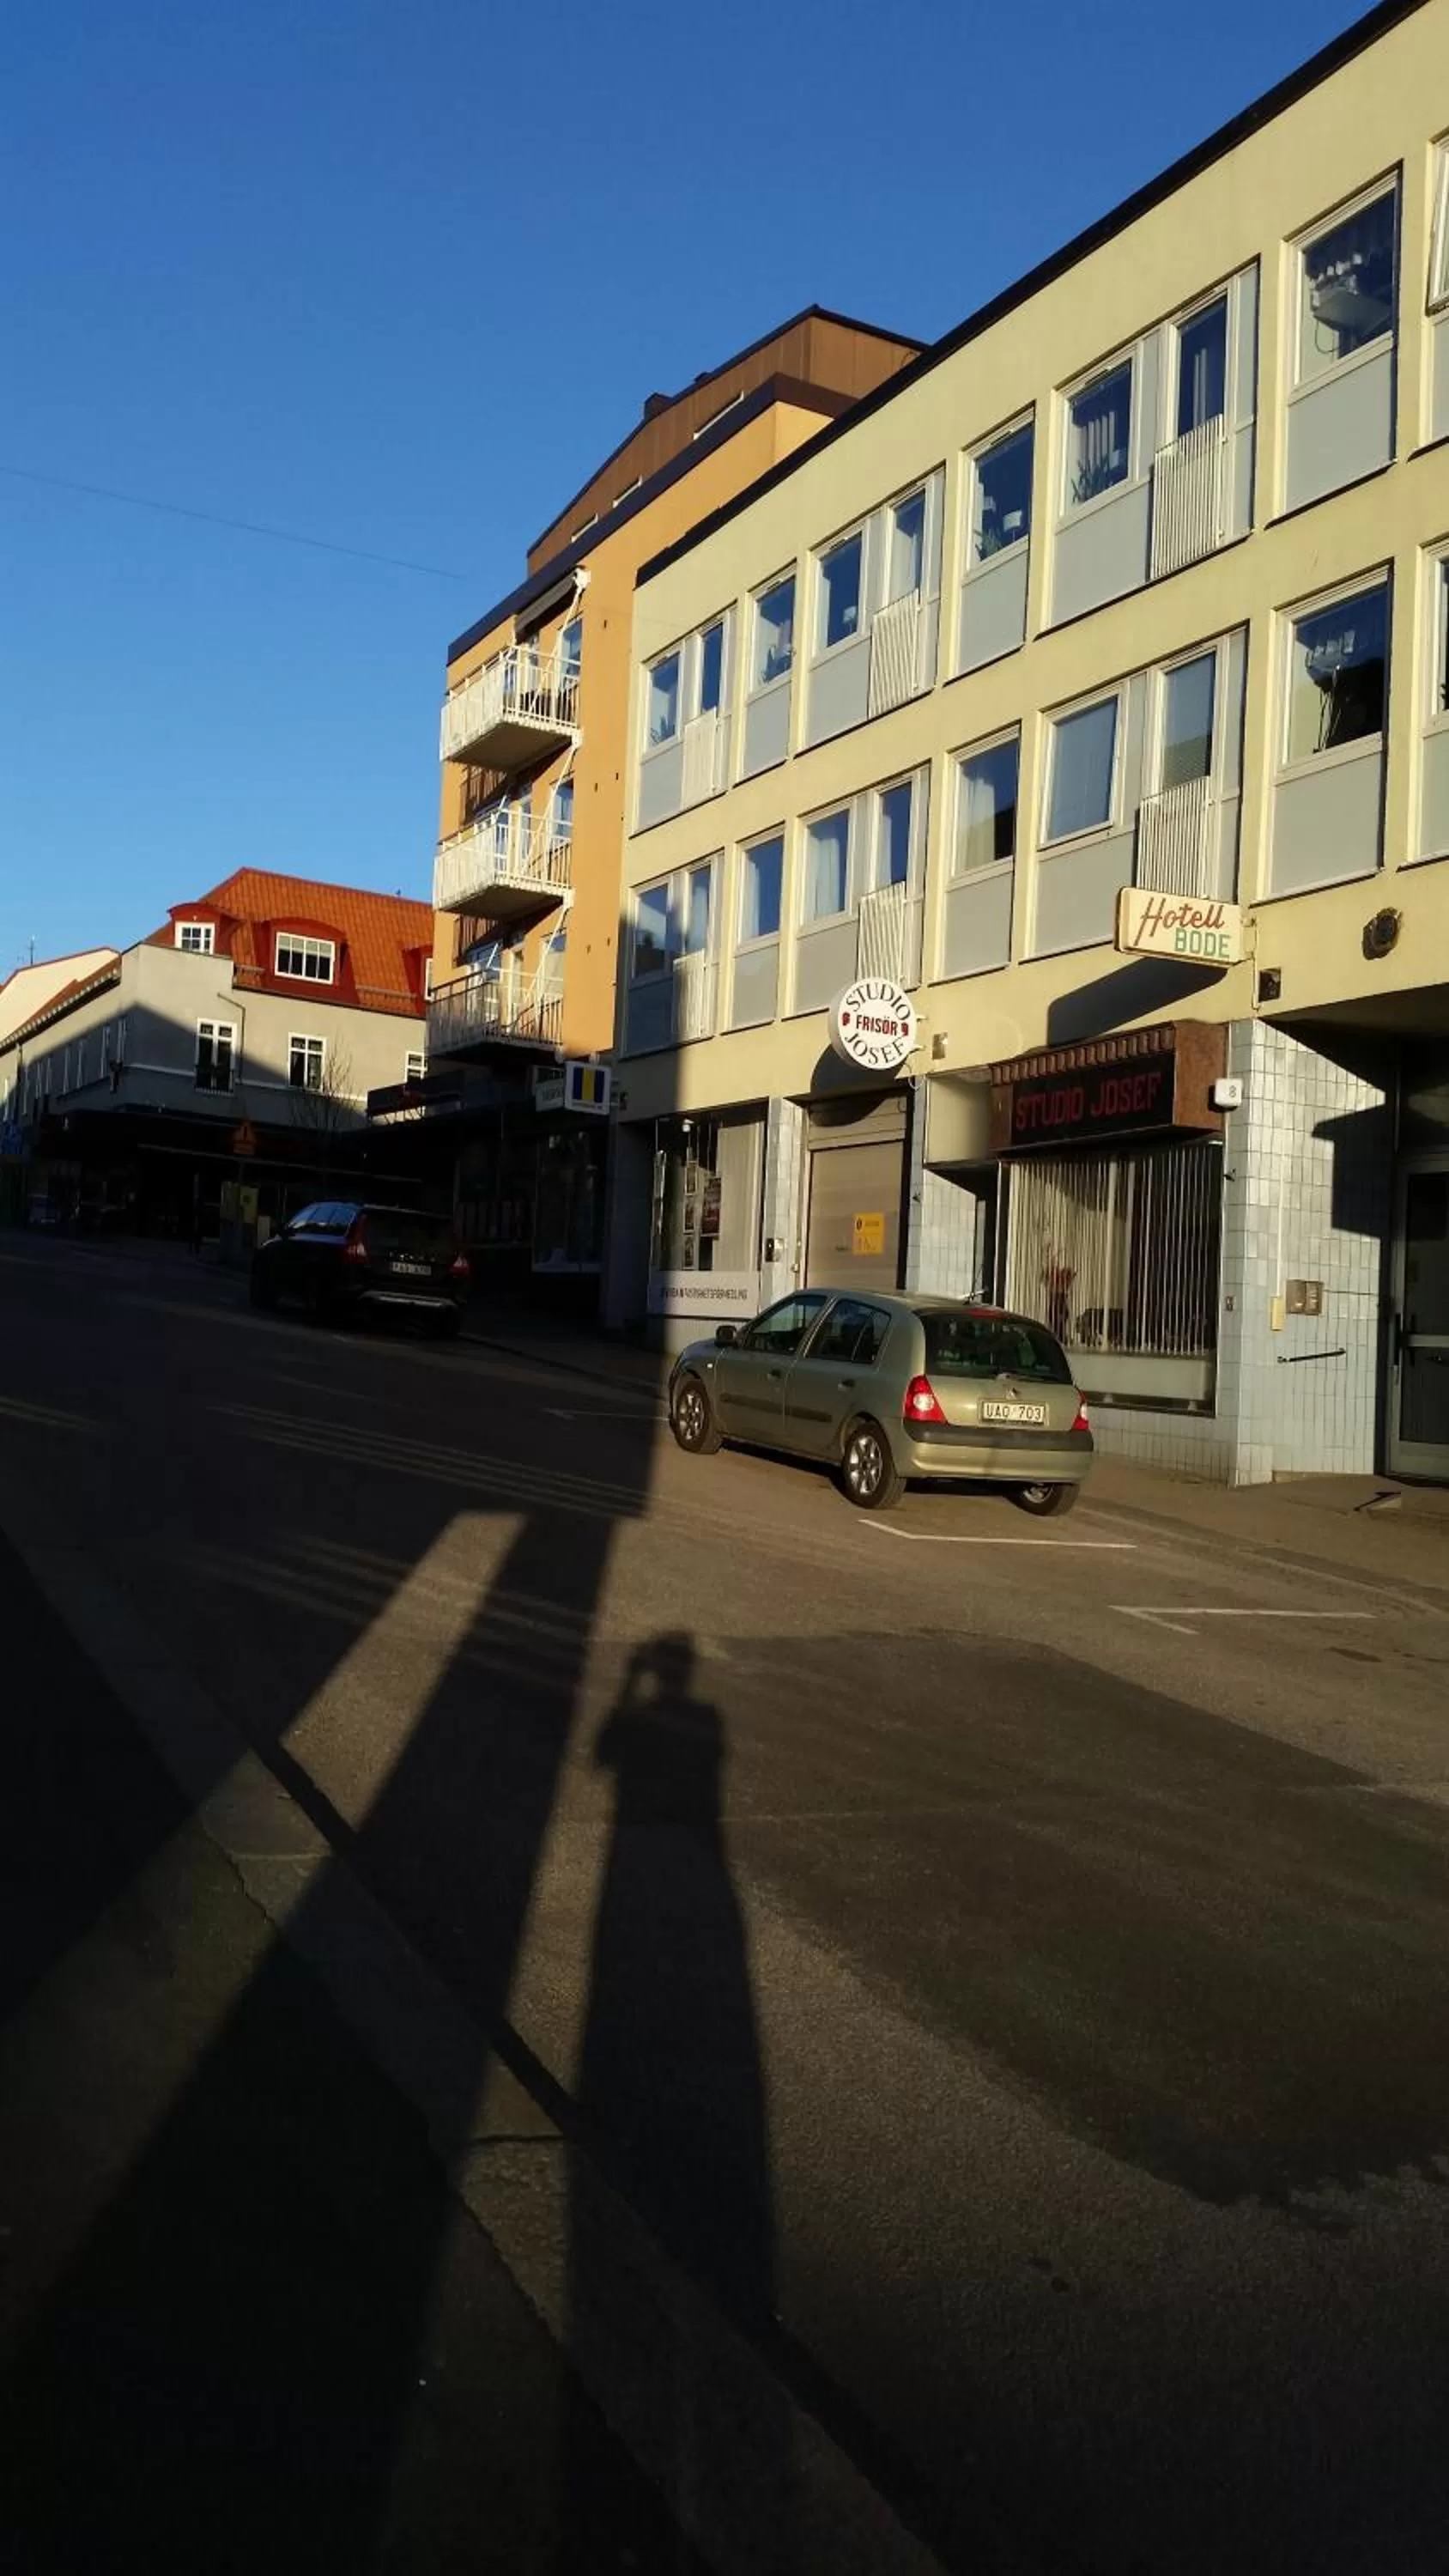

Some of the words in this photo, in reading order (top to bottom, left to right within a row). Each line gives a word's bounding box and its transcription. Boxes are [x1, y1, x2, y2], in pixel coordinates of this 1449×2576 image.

[1133, 896, 1225, 946] Hotell
[1174, 927, 1231, 958] BODE
[846, 982, 911, 1021] STUDIO
[856, 1014, 898, 1036] FRISÖR
[844, 1033, 905, 1065] JOSEF
[1016, 1085, 1084, 1131] STUDIO
[1090, 1072, 1162, 1117] JOSEF
[1018, 1405, 1041, 1420] 703
